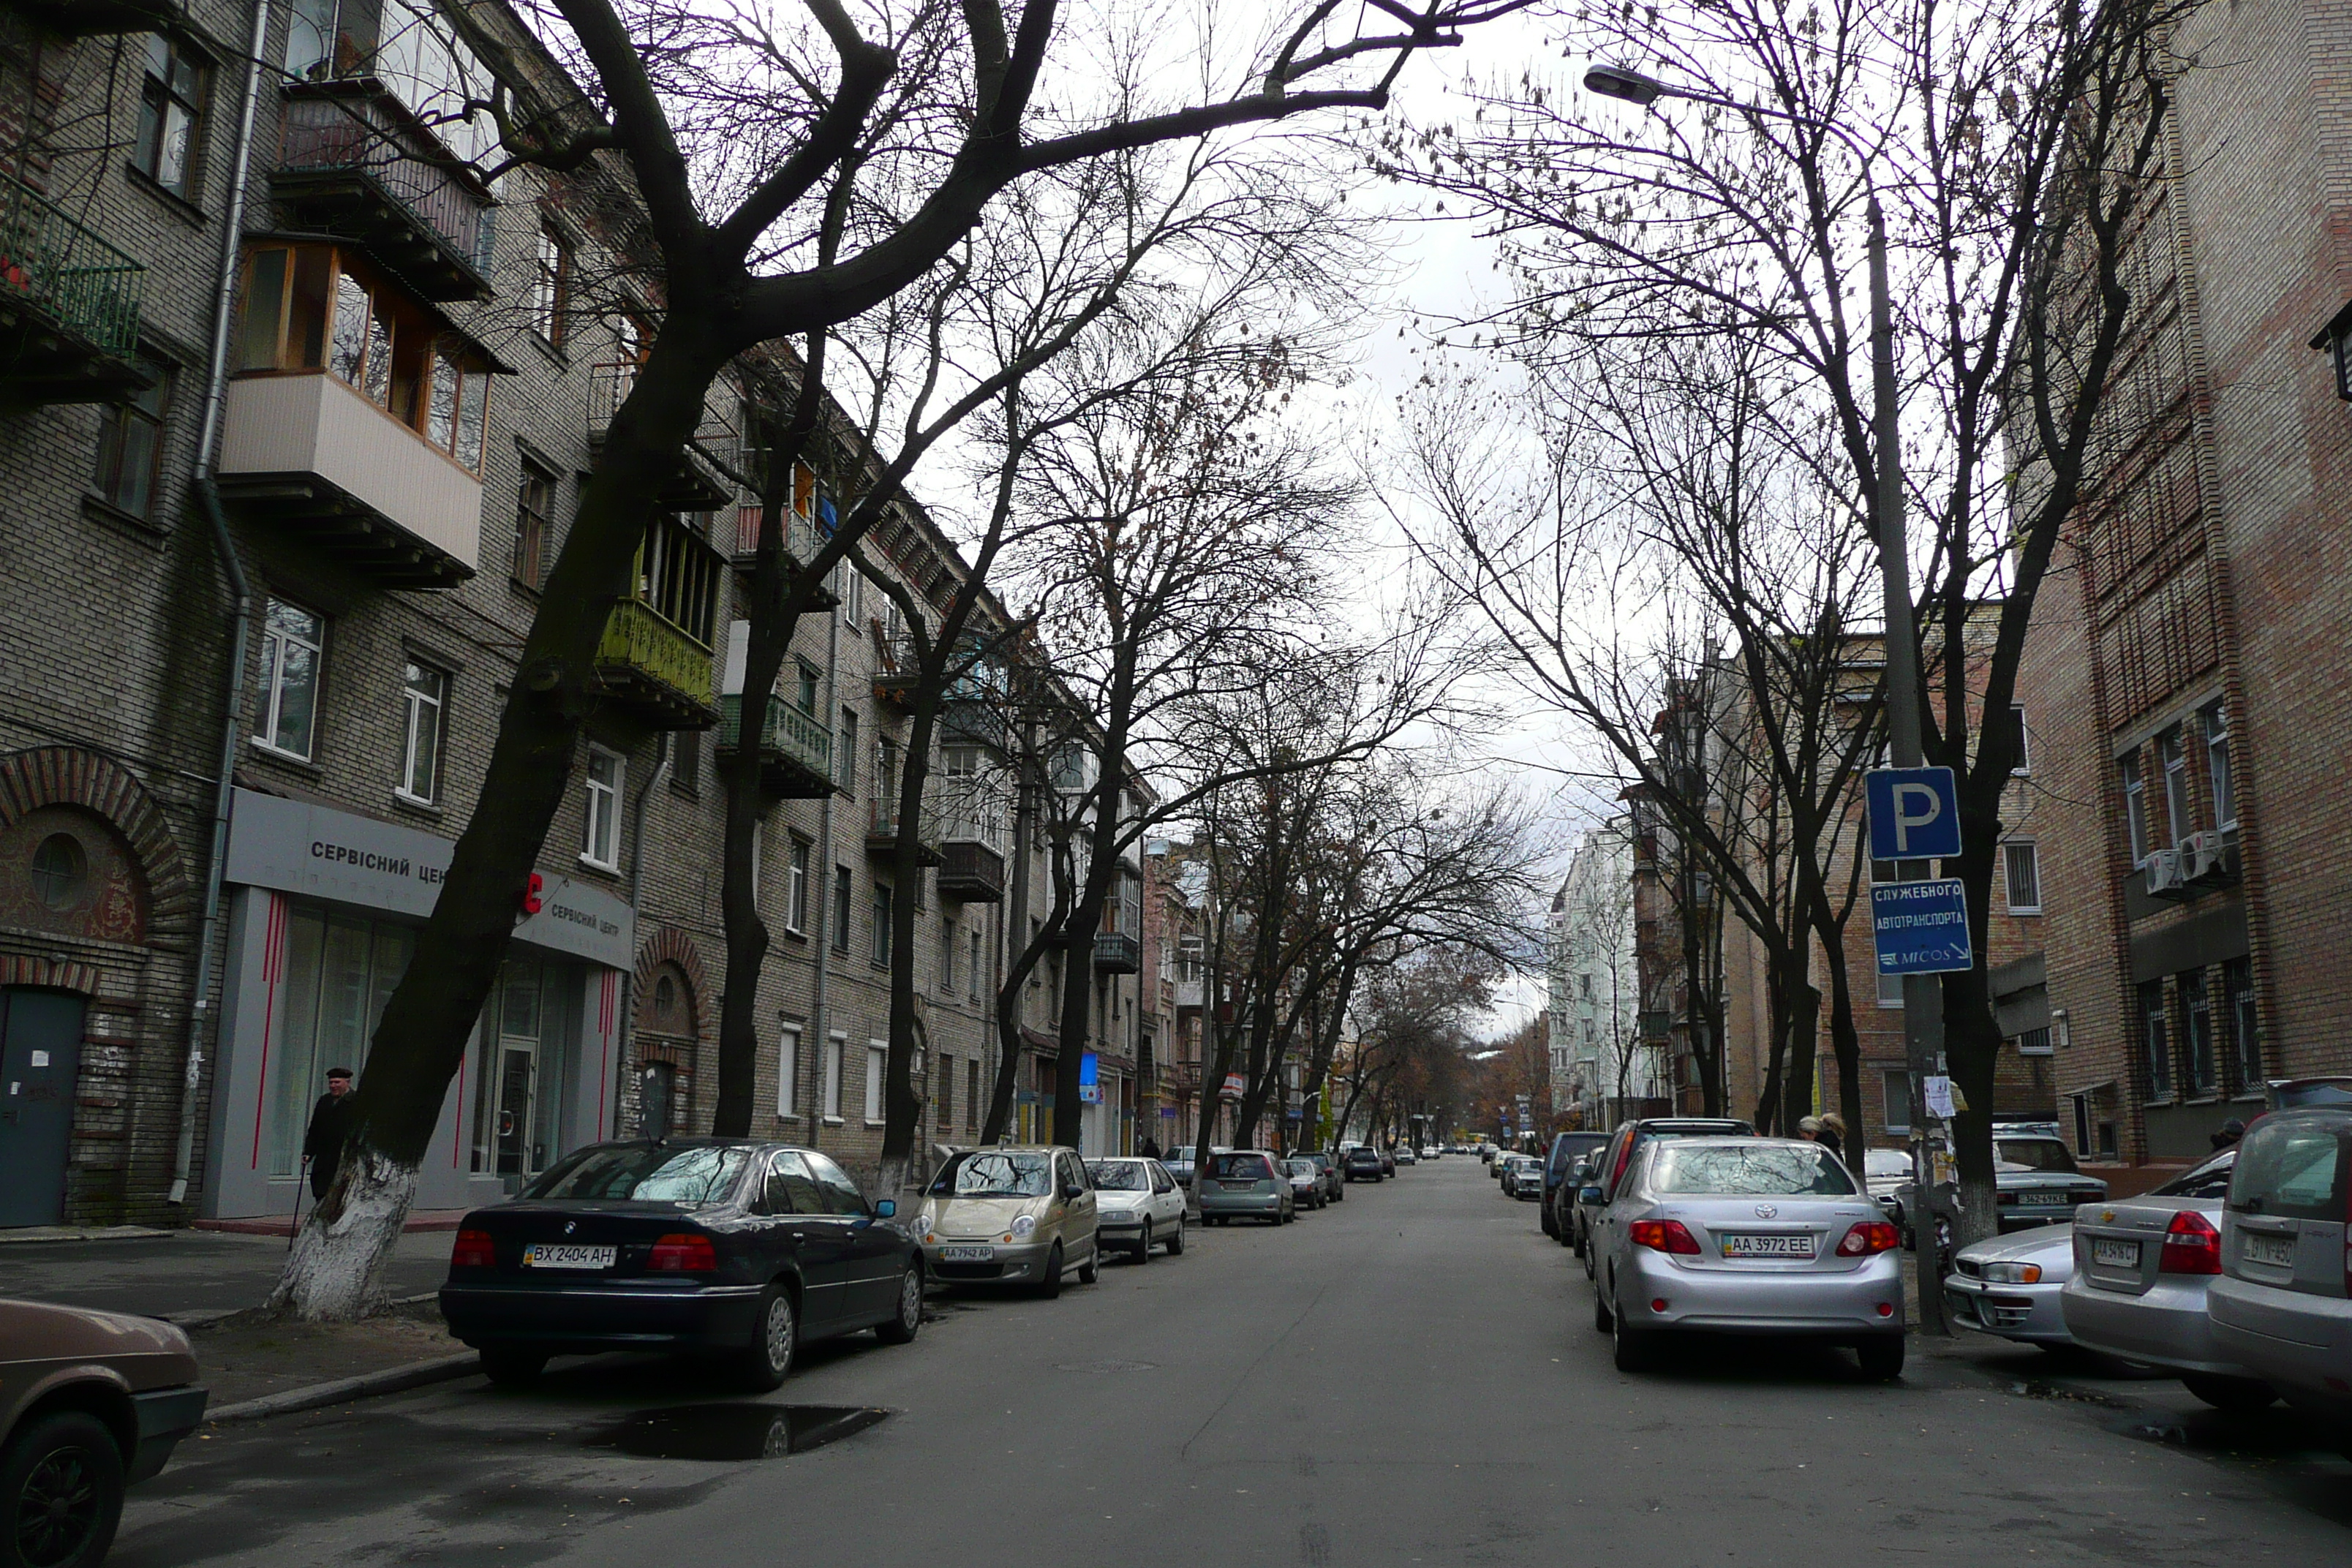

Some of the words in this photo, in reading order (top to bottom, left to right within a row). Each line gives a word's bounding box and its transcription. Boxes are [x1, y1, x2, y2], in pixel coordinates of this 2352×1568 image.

[1892, 783, 1940, 852] P
[312, 842, 410, 876] СЕРВІСНИЙ
[419, 865, 447, 884] ЦЕН
[1875, 884, 1961, 902] СЛУЖЕБНОГО
[551, 904, 597, 930] СЕРВІСНИЙ
[599, 919, 619, 937] ЦЕНТР
[1877, 912, 1964, 930] АВТОТРАНСПОРТА
[1901, 950, 1950, 965] MICOS
[945, 1248, 956, 1257] AA
[958, 1248, 977, 1257] 7942
[979, 1248, 991, 1257] AP
[1733, 1238, 1752, 1251] AA
[1756, 1238, 1786, 1252] 3972
[1790, 1238, 1809, 1251] EE
[534, 1247, 554, 1261] BX
[557, 1248, 587, 1262] 2404
[591, 1248, 612, 1263] AH
